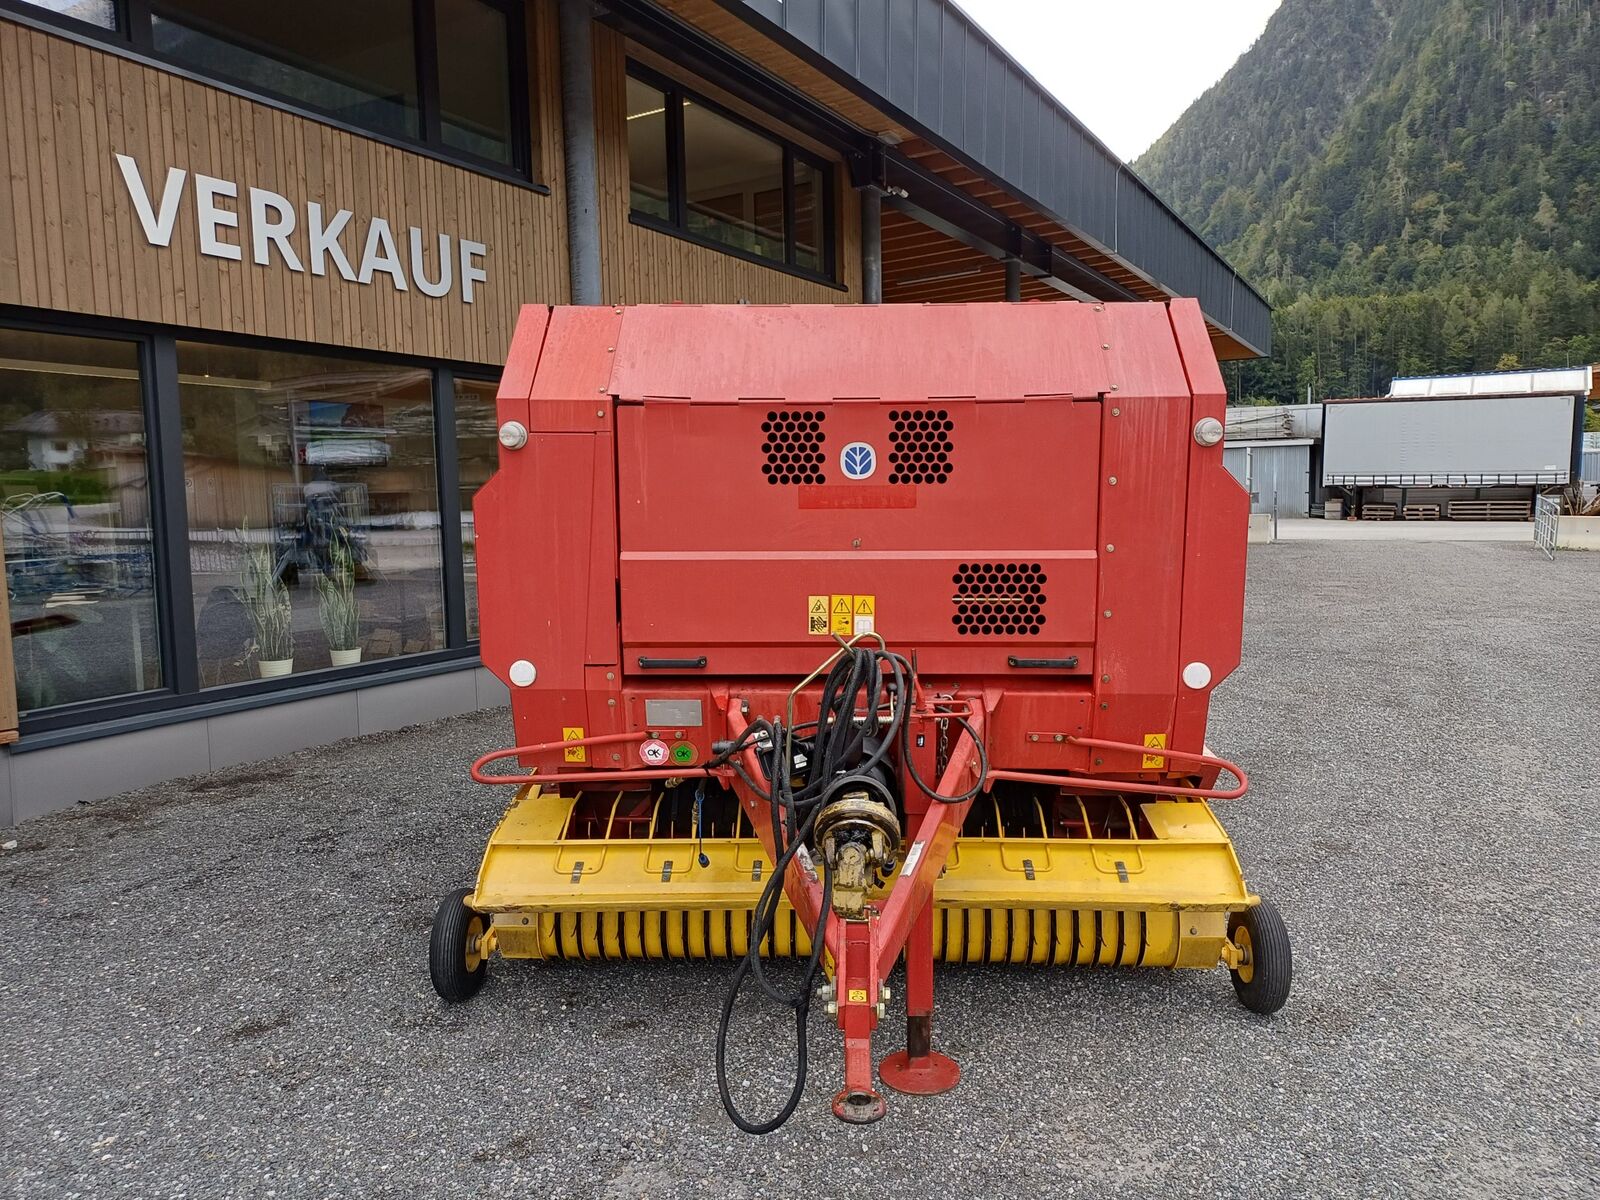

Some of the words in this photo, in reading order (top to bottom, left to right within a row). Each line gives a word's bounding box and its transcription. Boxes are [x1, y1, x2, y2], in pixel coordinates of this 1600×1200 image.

[115, 153, 488, 304] VERKAUF
[647, 748, 661, 758] OK
[676, 750, 690, 758] OK
